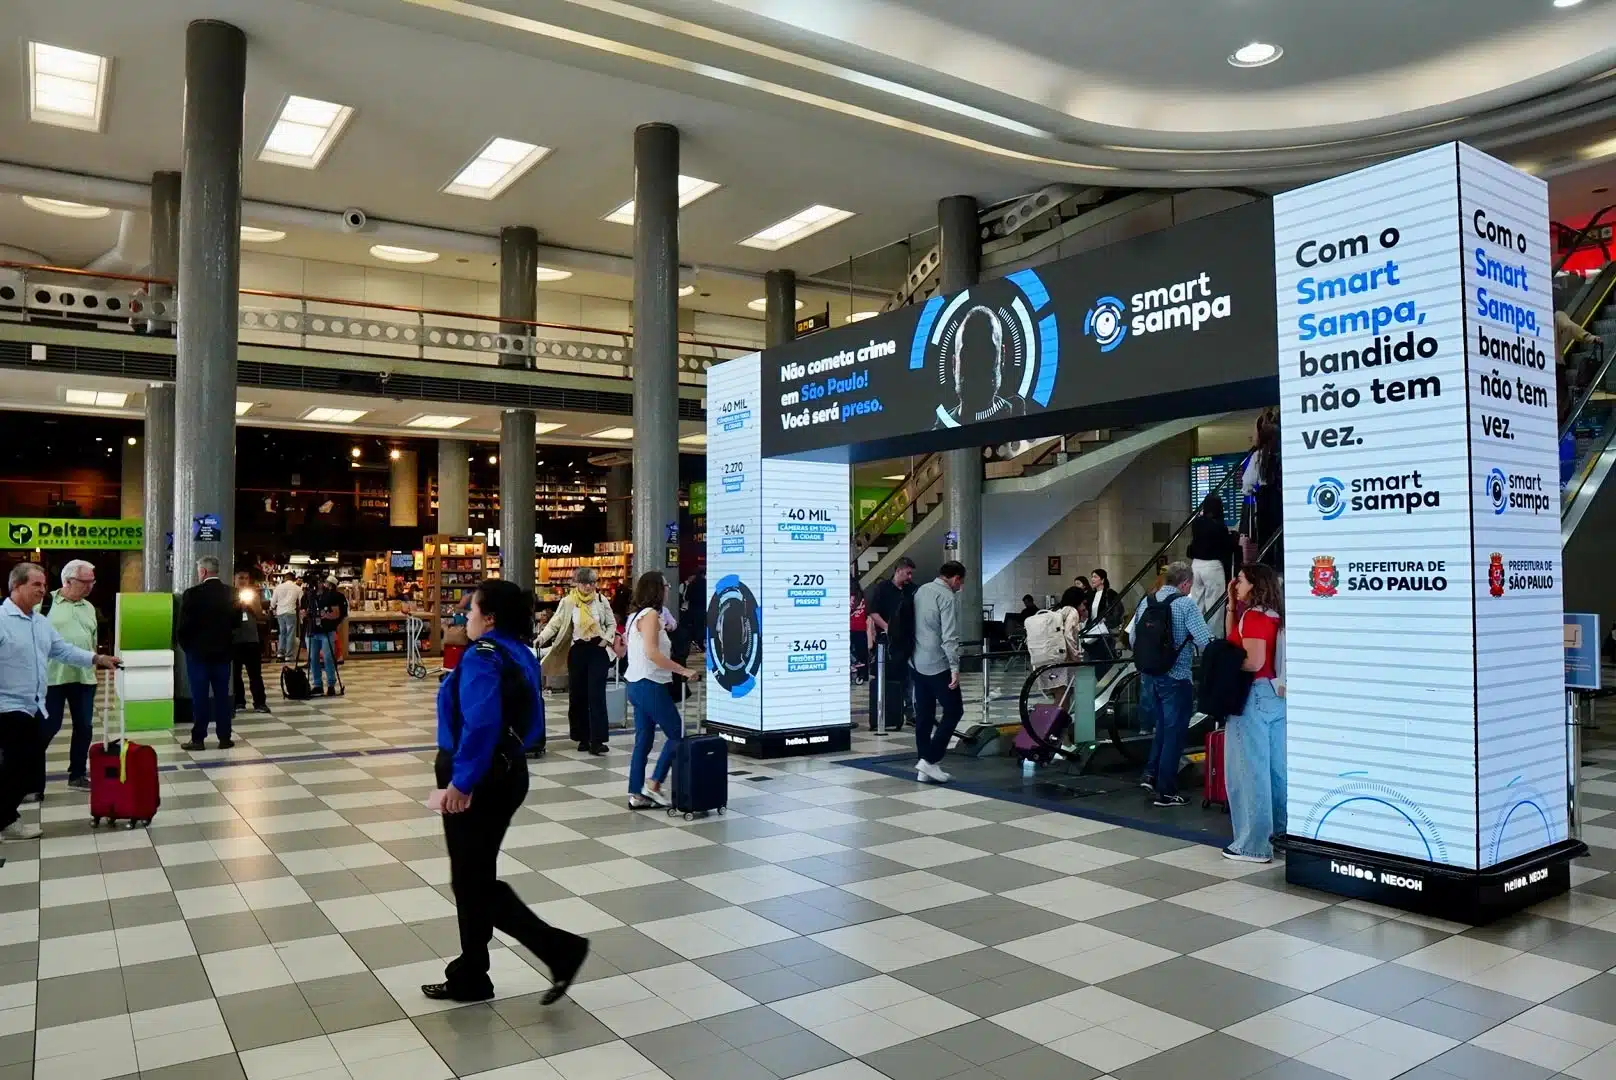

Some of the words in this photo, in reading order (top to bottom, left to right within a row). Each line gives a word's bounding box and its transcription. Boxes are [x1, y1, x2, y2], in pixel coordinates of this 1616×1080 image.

[1473, 209, 1513, 250] Com
[1517, 233, 1527, 254] o
[1295, 234, 1369, 268] Com
[1379, 227, 1400, 249] o
[1296, 260, 1400, 305] Smart
[1475, 247, 1529, 292] Smart
[1131, 271, 1212, 313] smart
[1131, 295, 1231, 337] sampa
[1298, 300, 1426, 341] Sampa,
[1476, 287, 1541, 337] Sampa,
[780, 363, 806, 383] Não
[807, 350, 855, 376] cometa
[857, 339, 897, 362] crime
[1299, 331, 1439, 378] bandido
[1478, 326, 1546, 370] bandido
[780, 390, 800, 407] em
[801, 382, 825, 402] São
[827, 369, 869, 396] Paulo!
[1300, 382, 1361, 414] não
[1370, 375, 1441, 405] tem
[1480, 369, 1512, 402] não
[1516, 376, 1548, 409] tem
[733, 399, 748, 411] MIL
[780, 408, 811, 431] Você
[811, 402, 840, 424] será
[841, 397, 884, 423] preso.
[1302, 426, 1364, 449] vez.
[1481, 414, 1515, 442] vez.
[1351, 470, 1423, 493] smart
[1508, 473, 1542, 491] smart
[809, 510, 831, 522] MIL
[1351, 490, 1440, 514] sampa
[1509, 492, 1549, 515] sampa
[38, 521, 143, 541] Deltaexpres
[543, 543, 572, 553] travel
[1348, 561, 1424, 572] PREFEITURA
[1428, 561, 1446, 572] DE
[1508, 560, 1545, 571] PREFEITURA
[1545, 561, 1553, 571] DE
[1348, 574, 1384, 591] SÃO
[1387, 576, 1447, 591] PAULO
[1509, 573, 1527, 590] SÃO
[1528, 575, 1554, 589] PAULO
[1380, 872, 1423, 892] NEOOH
